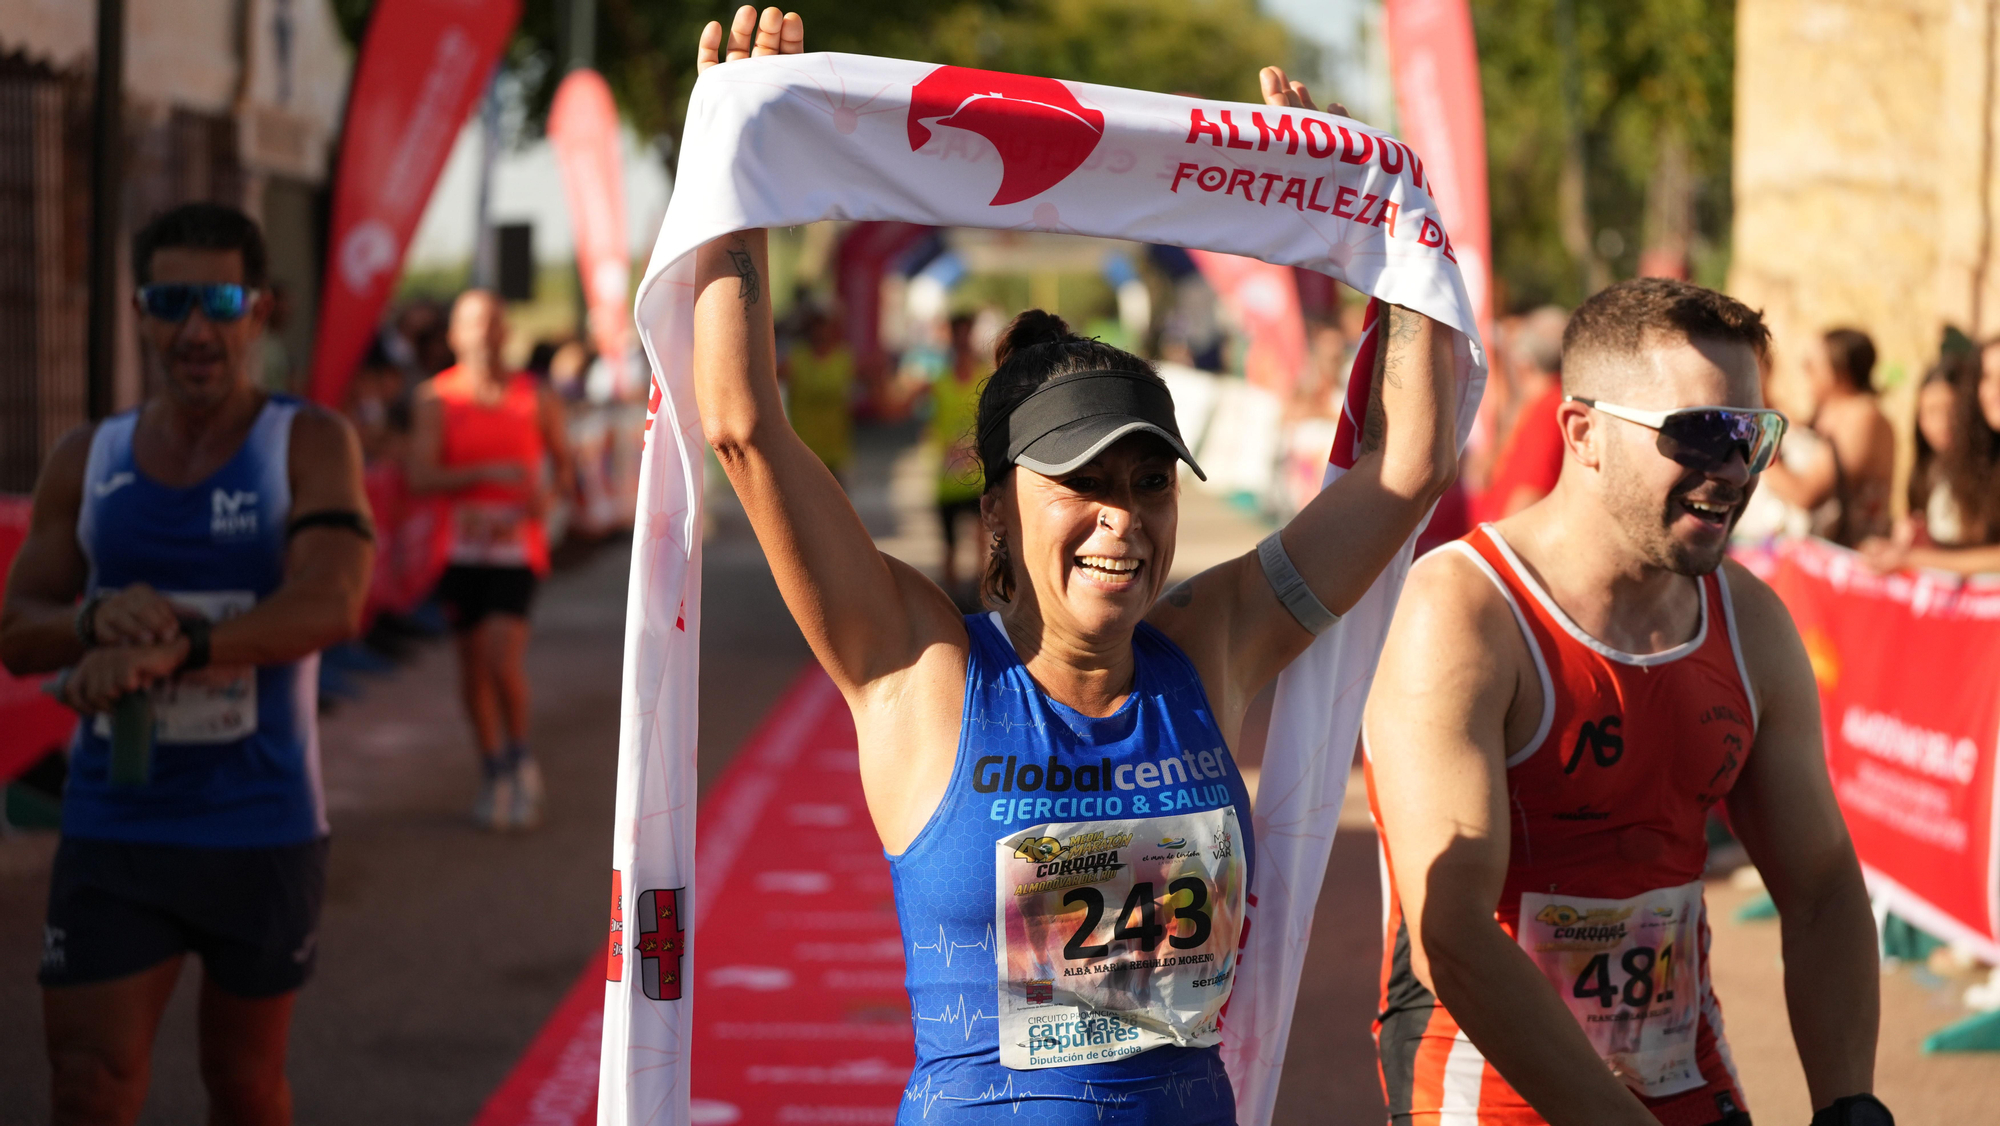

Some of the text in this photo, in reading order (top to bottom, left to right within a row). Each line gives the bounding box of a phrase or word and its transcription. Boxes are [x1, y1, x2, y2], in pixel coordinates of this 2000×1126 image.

[1170, 162, 1400, 239] FORTALEZA
[990, 784, 1231, 825] EJERCICIO & SALUD
[1067, 832, 1134, 860] MARATÓN
[1069, 831, 1105, 847] MEDIA
[1212, 849, 1232, 860] VAR
[1062, 876, 1212, 960] 243
[1063, 966, 1092, 977] ALBA
[1178, 953, 1215, 966] MORENO
[1572, 943, 1675, 1008] 481
[1028, 1013, 1068, 1025] CIRCUITO
[1028, 1016, 1121, 1039] carreras
[1029, 1026, 1139, 1056] populares
[1030, 1044, 1142, 1066] Diputación de Córdoba
